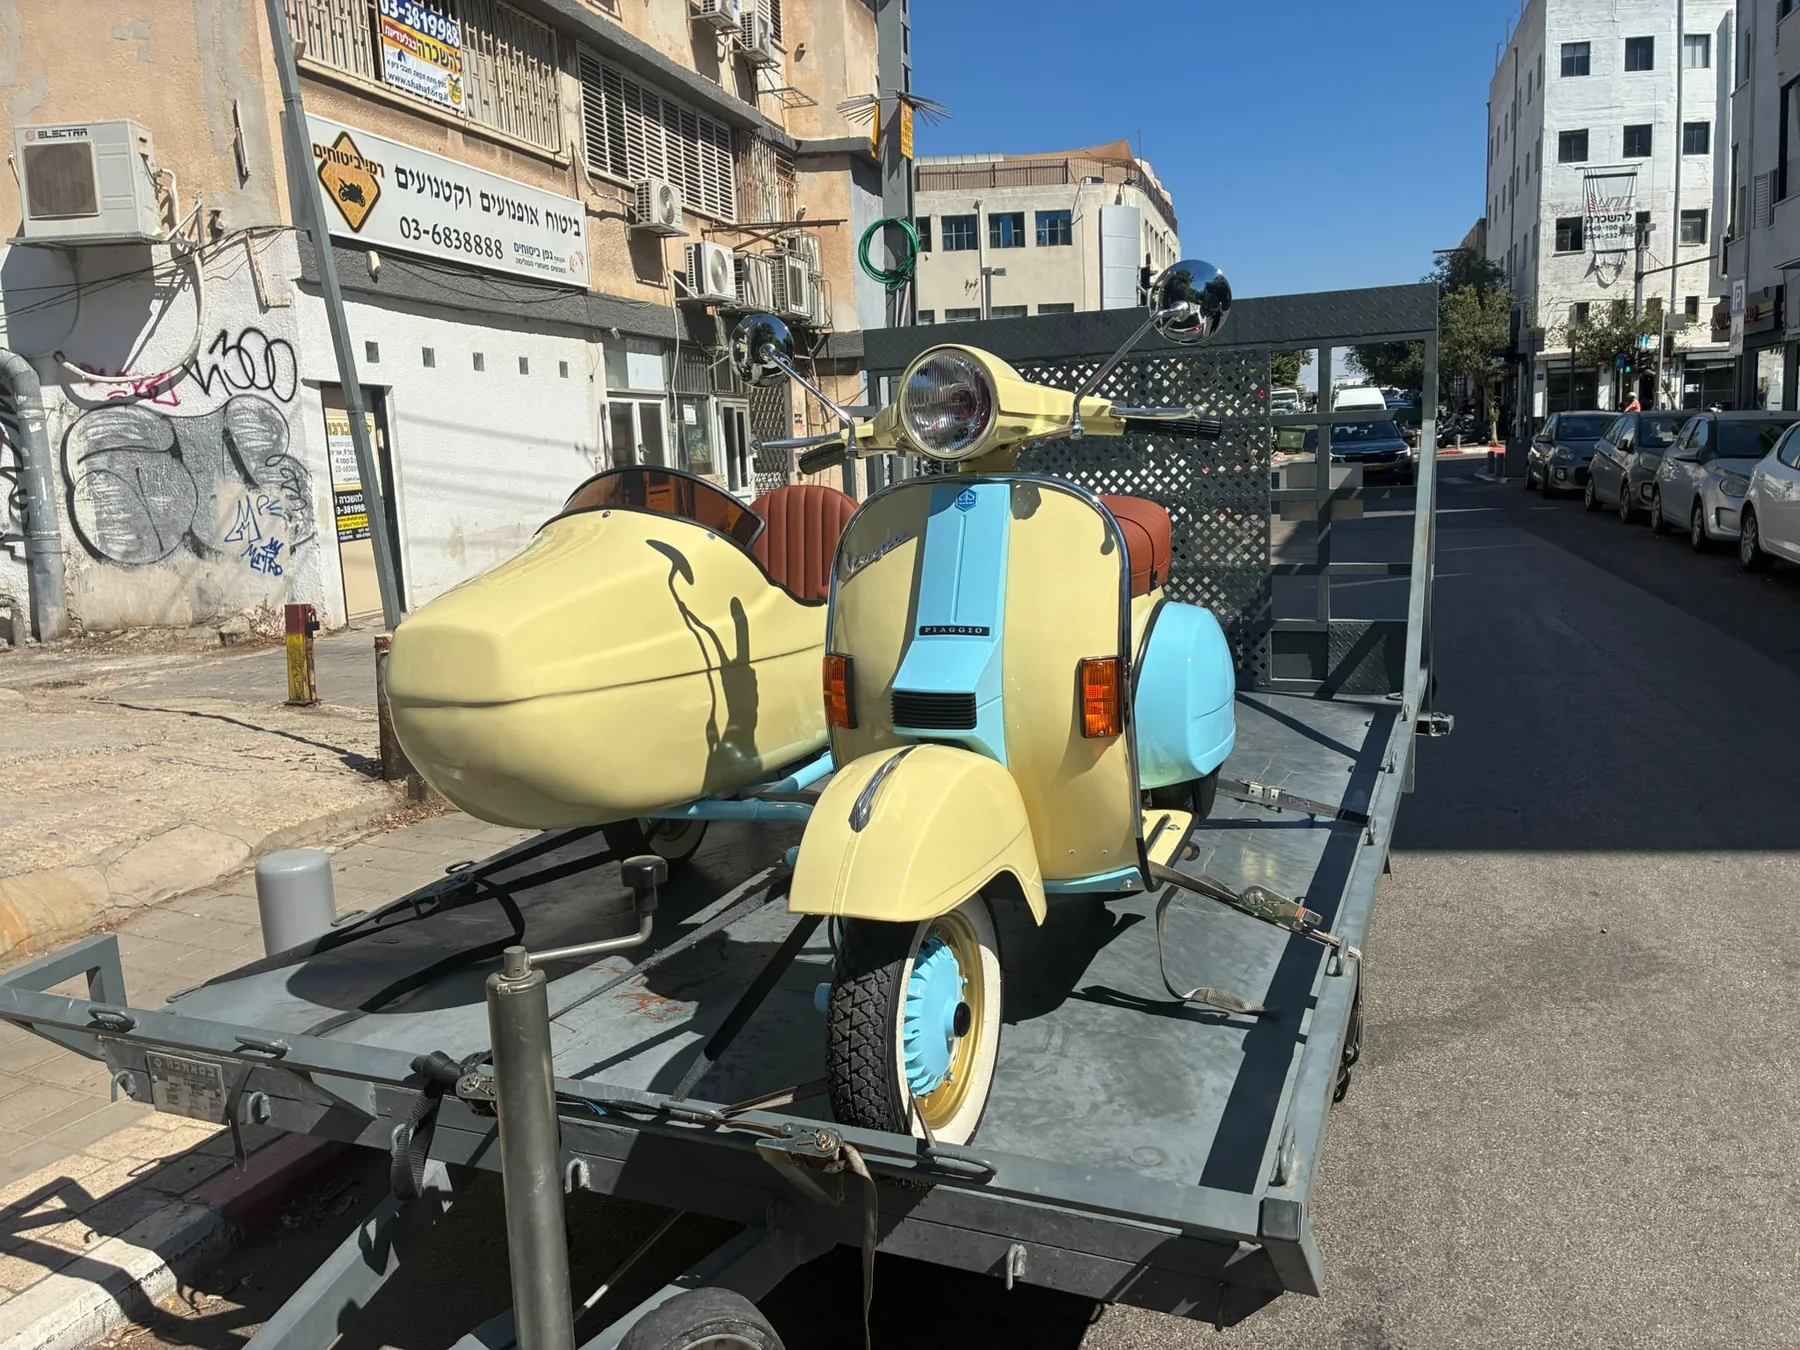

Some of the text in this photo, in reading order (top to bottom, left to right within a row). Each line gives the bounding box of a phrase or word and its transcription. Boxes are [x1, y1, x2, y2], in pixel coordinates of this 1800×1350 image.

[380, 0, 460, 47] 03-3819988
[417, 39, 463, 73] להשכרה
[37, 128, 88, 139] ELECTRA
[313, 143, 362, 170] ביטוחים
[394, 164, 581, 237] ביטוח אופנועים וקטנועים
[1586, 211, 1632, 224] להשכרה
[400, 216, 504, 260] 03-6838888
[513, 241, 540, 258] ביטוחים
[338, 493, 363, 504] להשכרה
